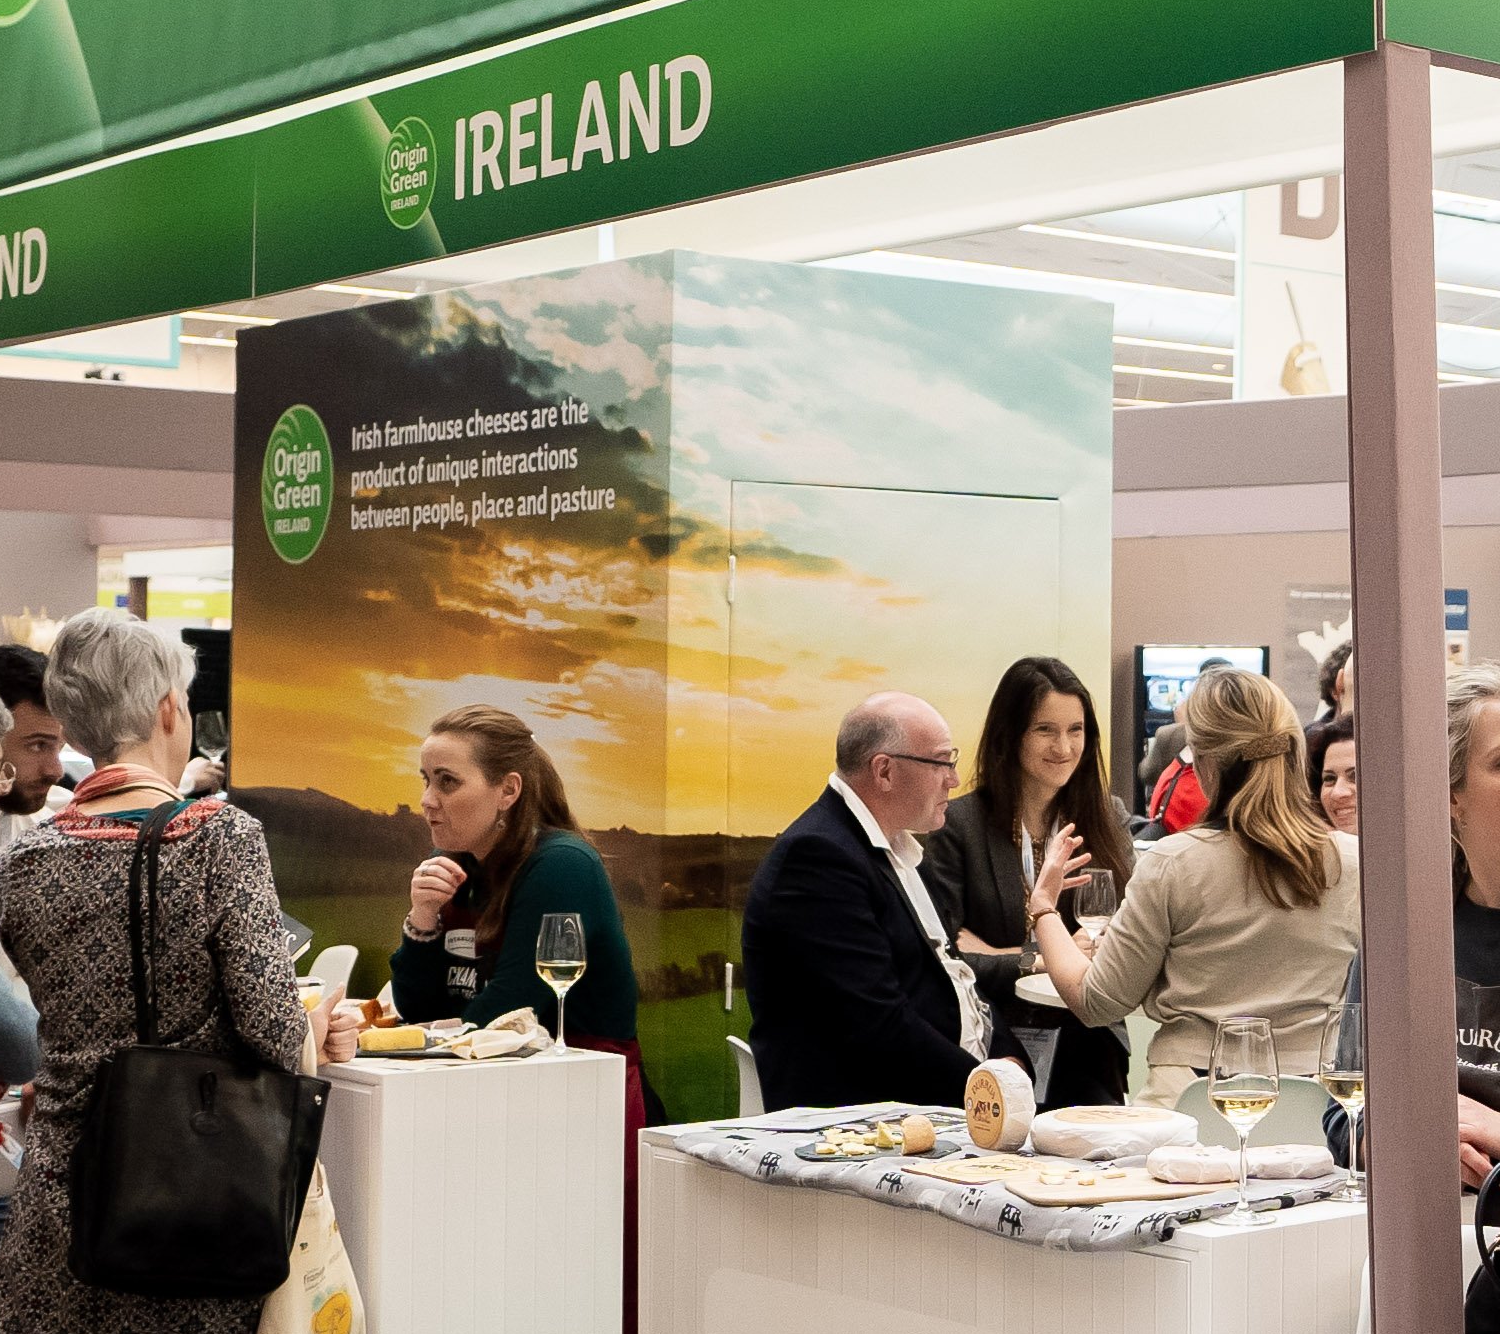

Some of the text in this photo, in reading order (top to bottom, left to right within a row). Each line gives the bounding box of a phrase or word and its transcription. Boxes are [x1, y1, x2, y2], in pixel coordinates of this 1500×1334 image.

[454, 54, 712, 200] IRELAND
[390, 143, 428, 172] Origin
[390, 169, 427, 194] Green
[391, 195, 419, 210] IRELAND
[351, 396, 589, 452] Irish farmhouse cheeses are the
[274, 443, 321, 483] Origin
[351, 443, 578, 497] product of unique interactions
[274, 481, 321, 512] Green
[351, 484, 616, 531] between people, place and pasture
[274, 517, 310, 535] IRELAND
